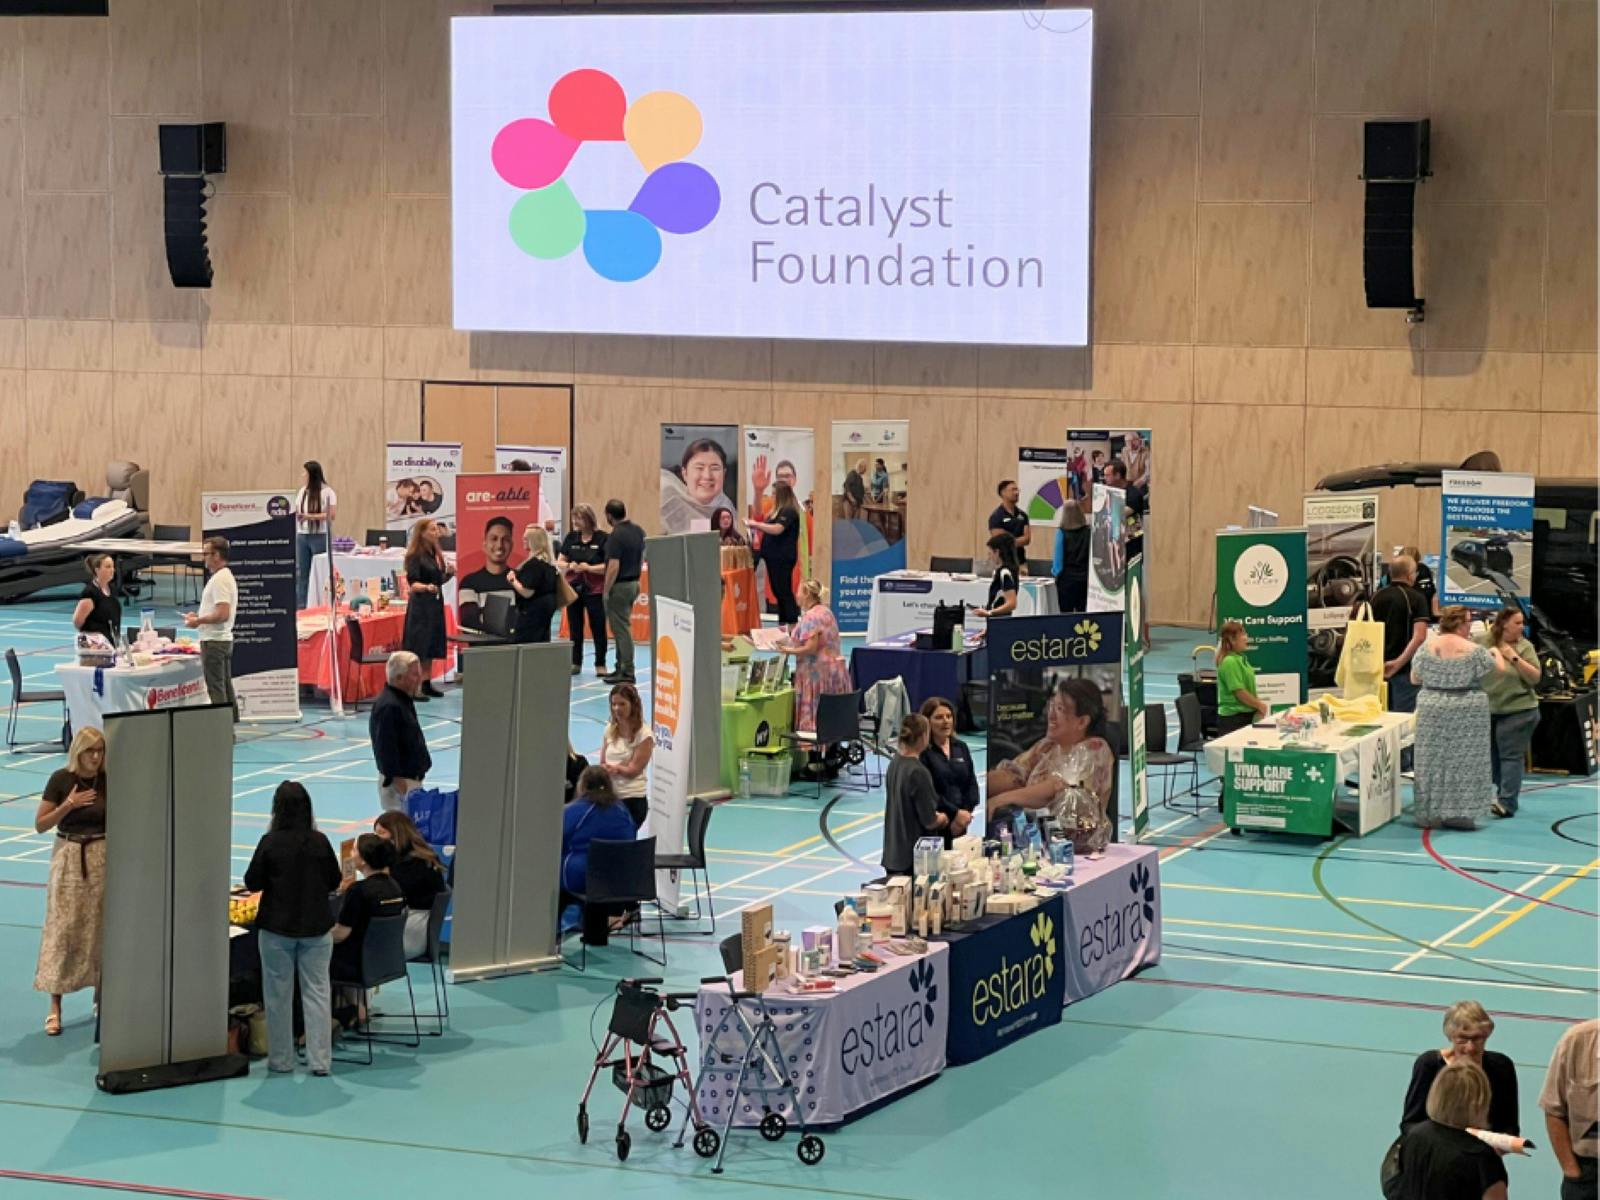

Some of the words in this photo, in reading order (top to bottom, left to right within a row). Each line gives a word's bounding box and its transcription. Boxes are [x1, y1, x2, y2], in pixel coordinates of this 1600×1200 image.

[749, 181, 953, 238] Catalyst
[751, 240, 1045, 288] Foundation
[404, 456, 441, 470] disability
[465, 484, 531, 504] are-able
[1447, 497, 1460, 505] WE
[840, 575, 859, 585] Find
[839, 589, 857, 599] you
[1245, 616, 1265, 625] Care
[1267, 614, 1303, 626] Support
[1011, 631, 1088, 662] estara
[1234, 763, 1260, 778] VIVA
[1263, 765, 1293, 780] CARE
[1233, 777, 1287, 793] SUPPORT
[1079, 897, 1146, 969] estara
[972, 952, 1047, 1026] estara
[840, 1000, 925, 1076] estara
